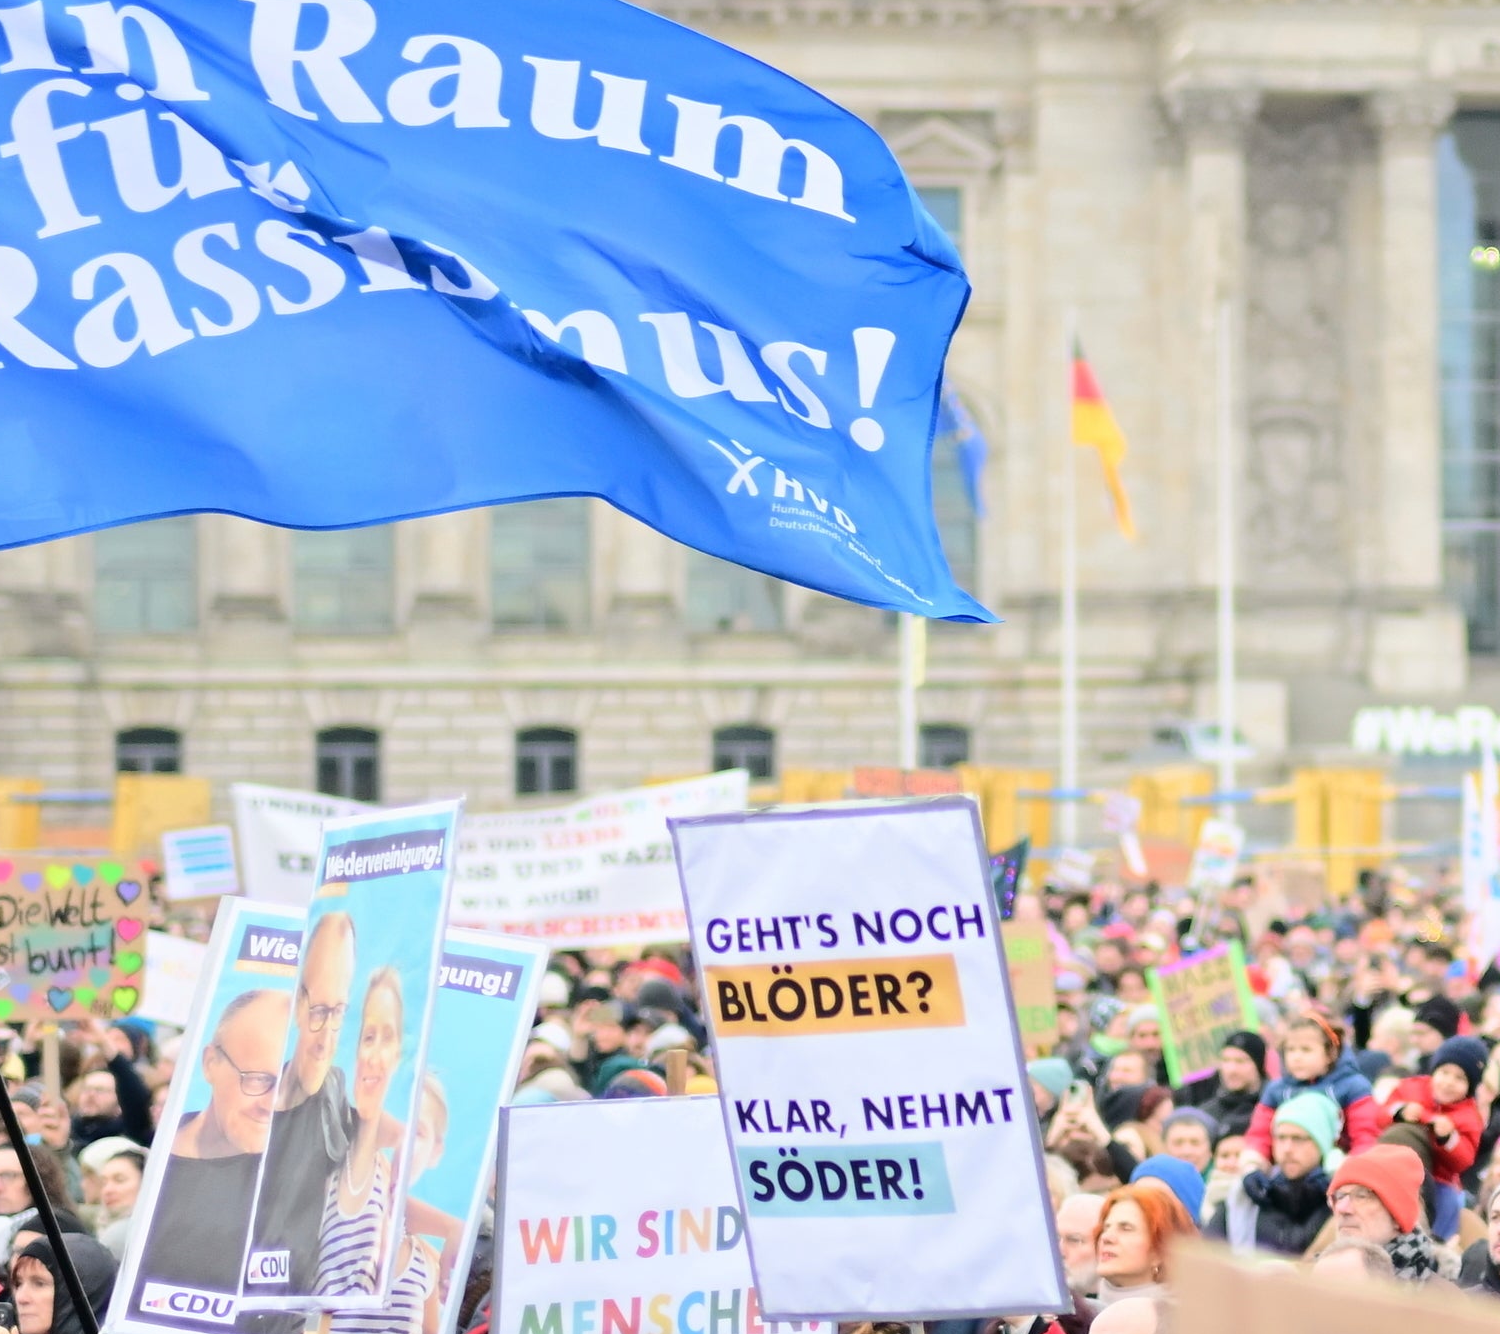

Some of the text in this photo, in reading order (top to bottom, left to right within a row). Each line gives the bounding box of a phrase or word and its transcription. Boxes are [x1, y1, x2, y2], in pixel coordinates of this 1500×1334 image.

[41, 887, 107, 928] Welt
[705, 903, 986, 954] GEHT'S NOCH
[25, 927, 117, 975] bunt!
[249, 933, 300, 959] Wie
[717, 963, 934, 1023] BLÖDER?
[734, 1087, 1014, 1139] KLAR, NEHMT
[748, 1146, 926, 1203] SÖDER!
[518, 1205, 744, 1266] WIR SIND
[260, 1256, 288, 1278] CDU
[168, 1292, 234, 1318] CDU
